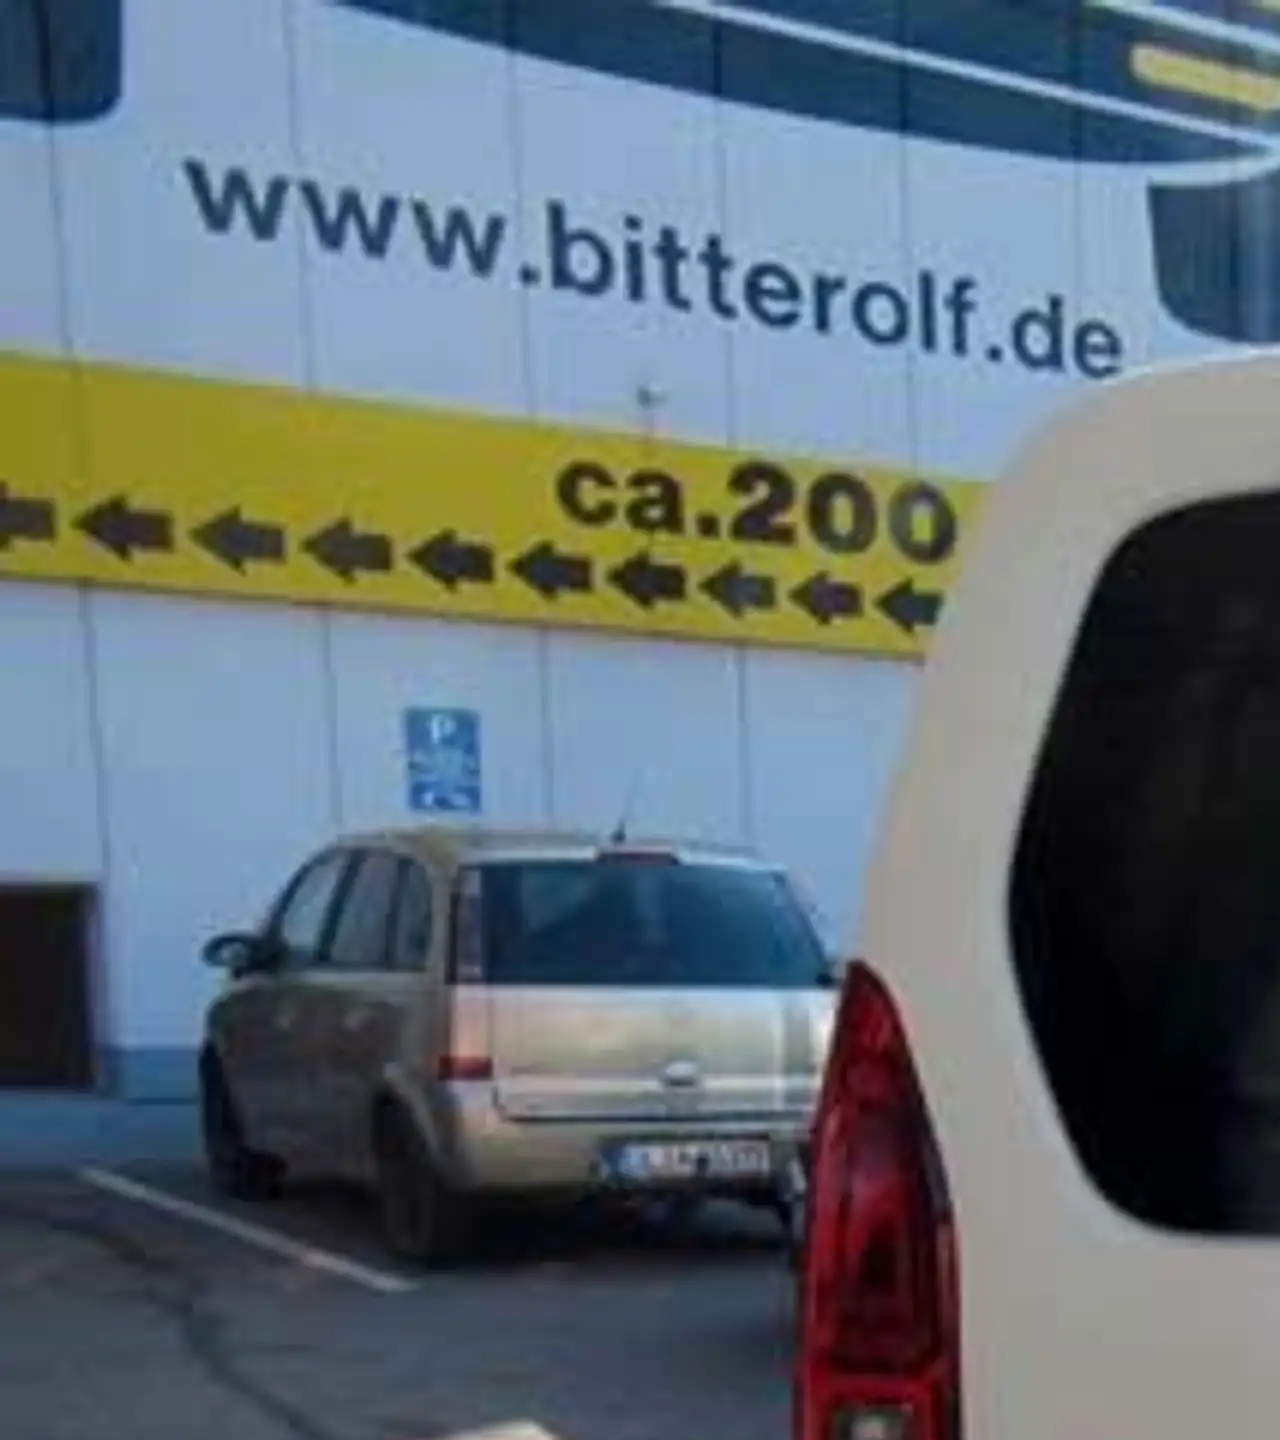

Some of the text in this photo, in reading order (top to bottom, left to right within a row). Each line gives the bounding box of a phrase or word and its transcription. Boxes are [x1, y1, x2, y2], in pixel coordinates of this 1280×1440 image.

[184, 156, 1123, 379] www.bitterolf.de
[556, 458, 958, 567] ca.200
[430, 712, 458, 745] P
